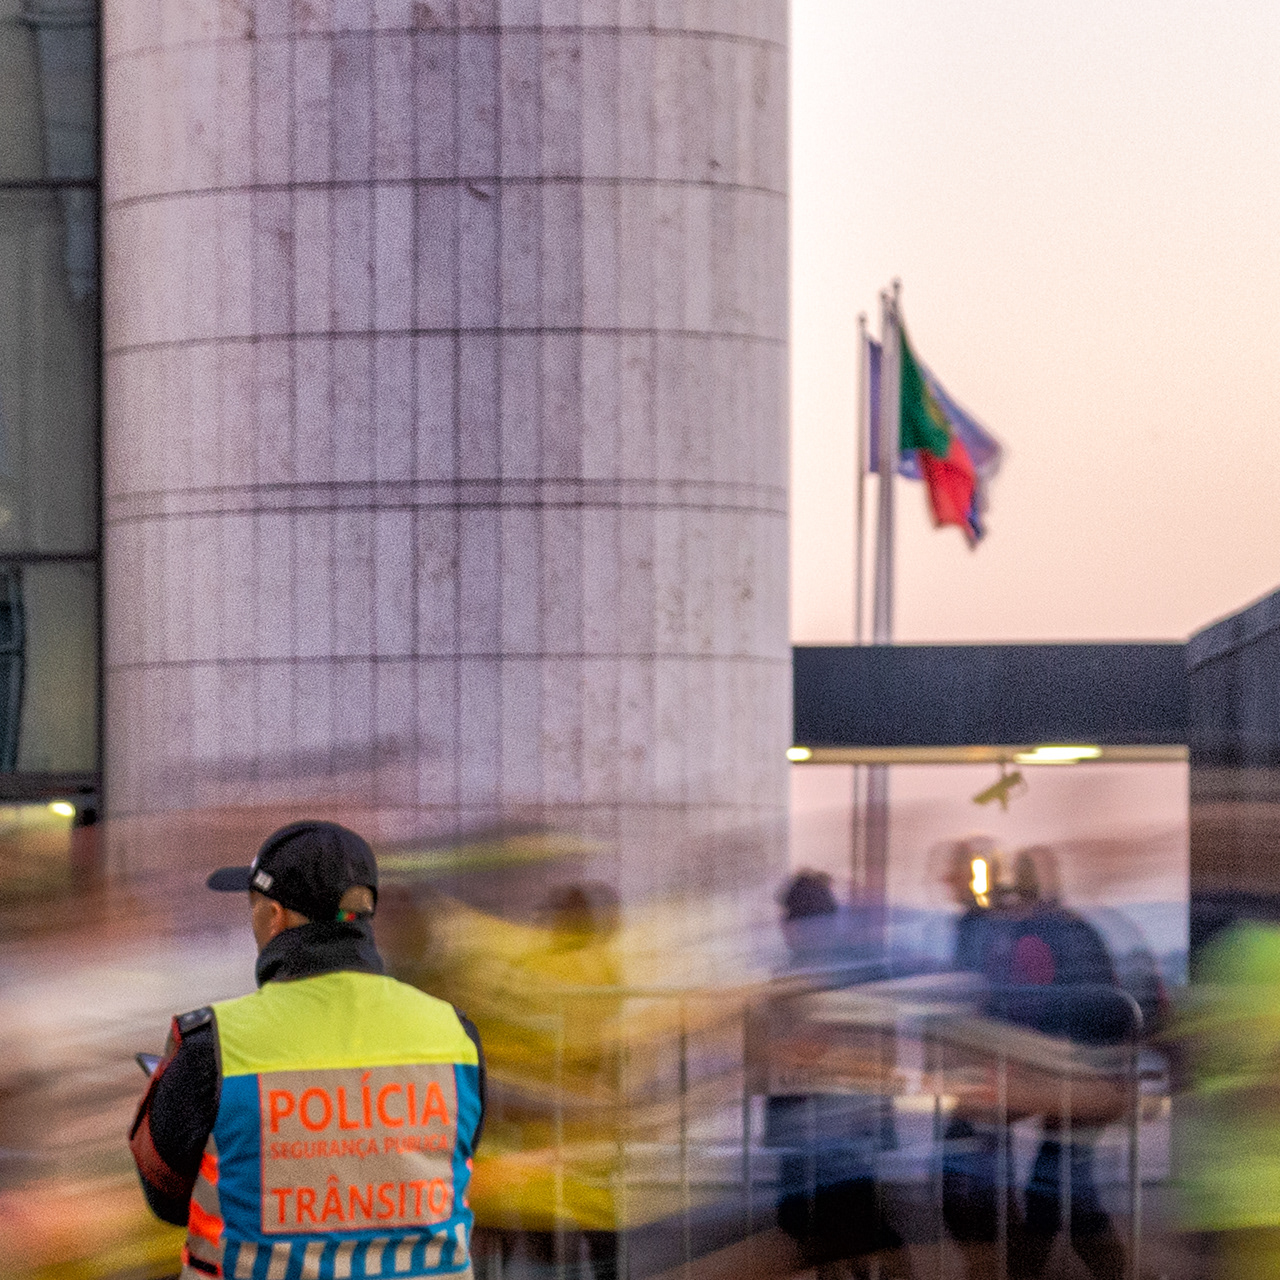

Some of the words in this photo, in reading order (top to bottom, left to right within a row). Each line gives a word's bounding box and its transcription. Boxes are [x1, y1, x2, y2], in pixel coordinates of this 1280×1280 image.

[268, 1071, 449, 1133] POLÍCIA
[271, 1138, 379, 1159] SEGURANÇA
[272, 1174, 449, 1223] TRÂNSITO
